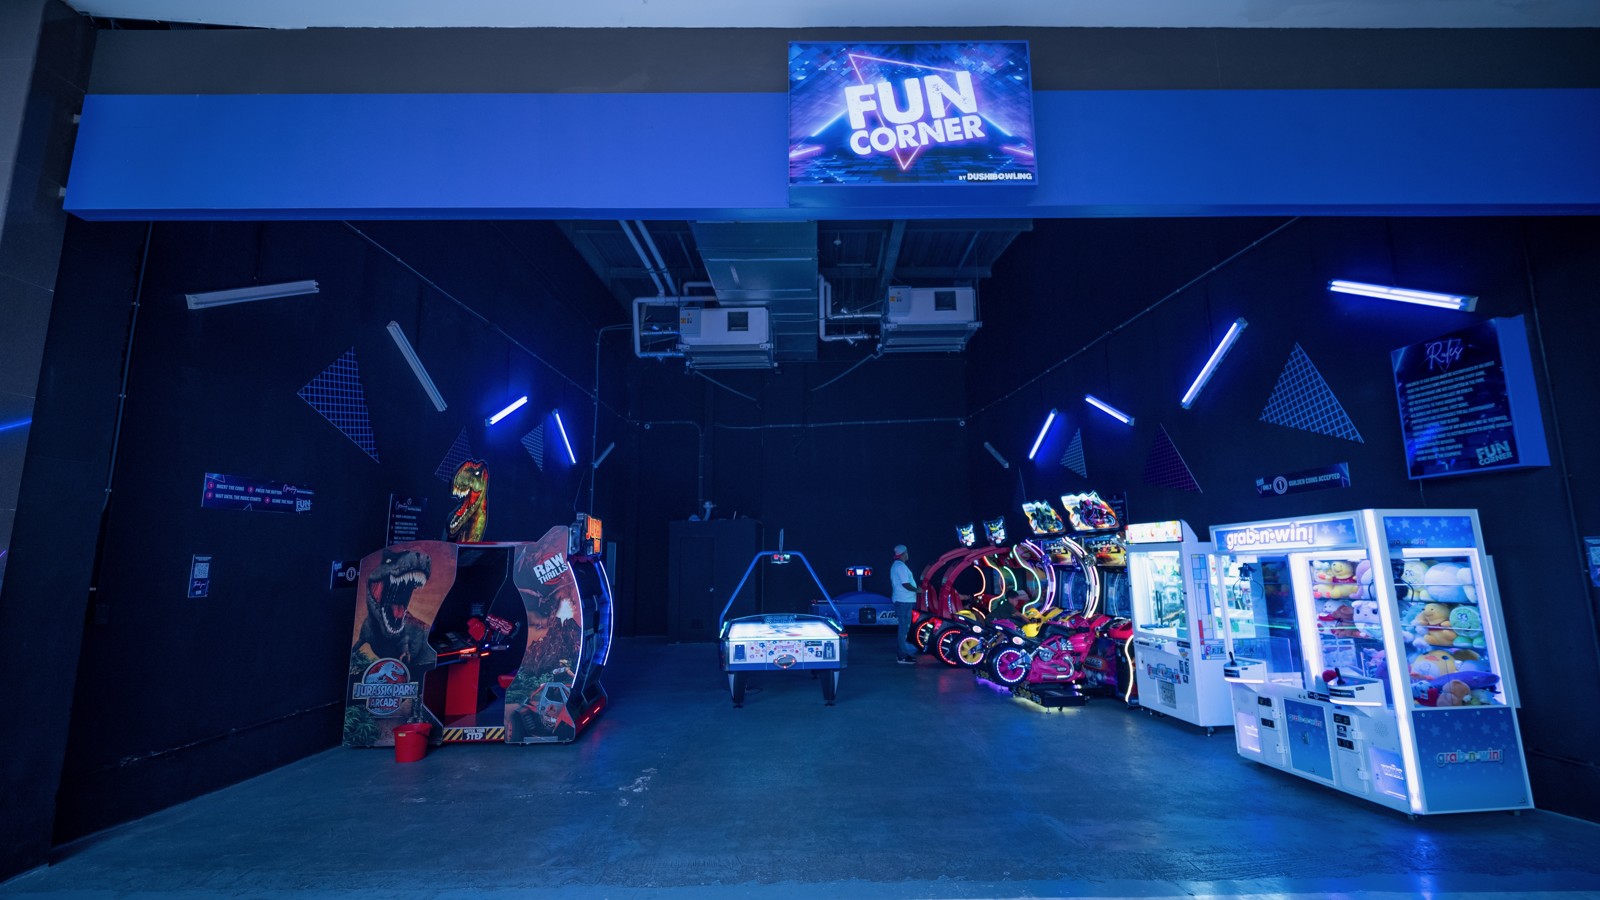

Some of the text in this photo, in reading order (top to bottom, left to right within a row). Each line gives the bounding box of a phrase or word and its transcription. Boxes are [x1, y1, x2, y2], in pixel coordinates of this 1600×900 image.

[844, 70, 978, 130] FUN
[849, 115, 986, 156] CORNER
[1426, 339, 1464, 370] Rules
[1475, 440, 1511, 460] FUN
[1478, 451, 1514, 466] CORNER
[533, 552, 564, 578] RAW
[537, 563, 569, 585] THRILLS
[355, 683, 416, 698] JURASSIC PARK
[370, 698, 399, 708] ARCADE
[466, 732, 484, 741] STEP
